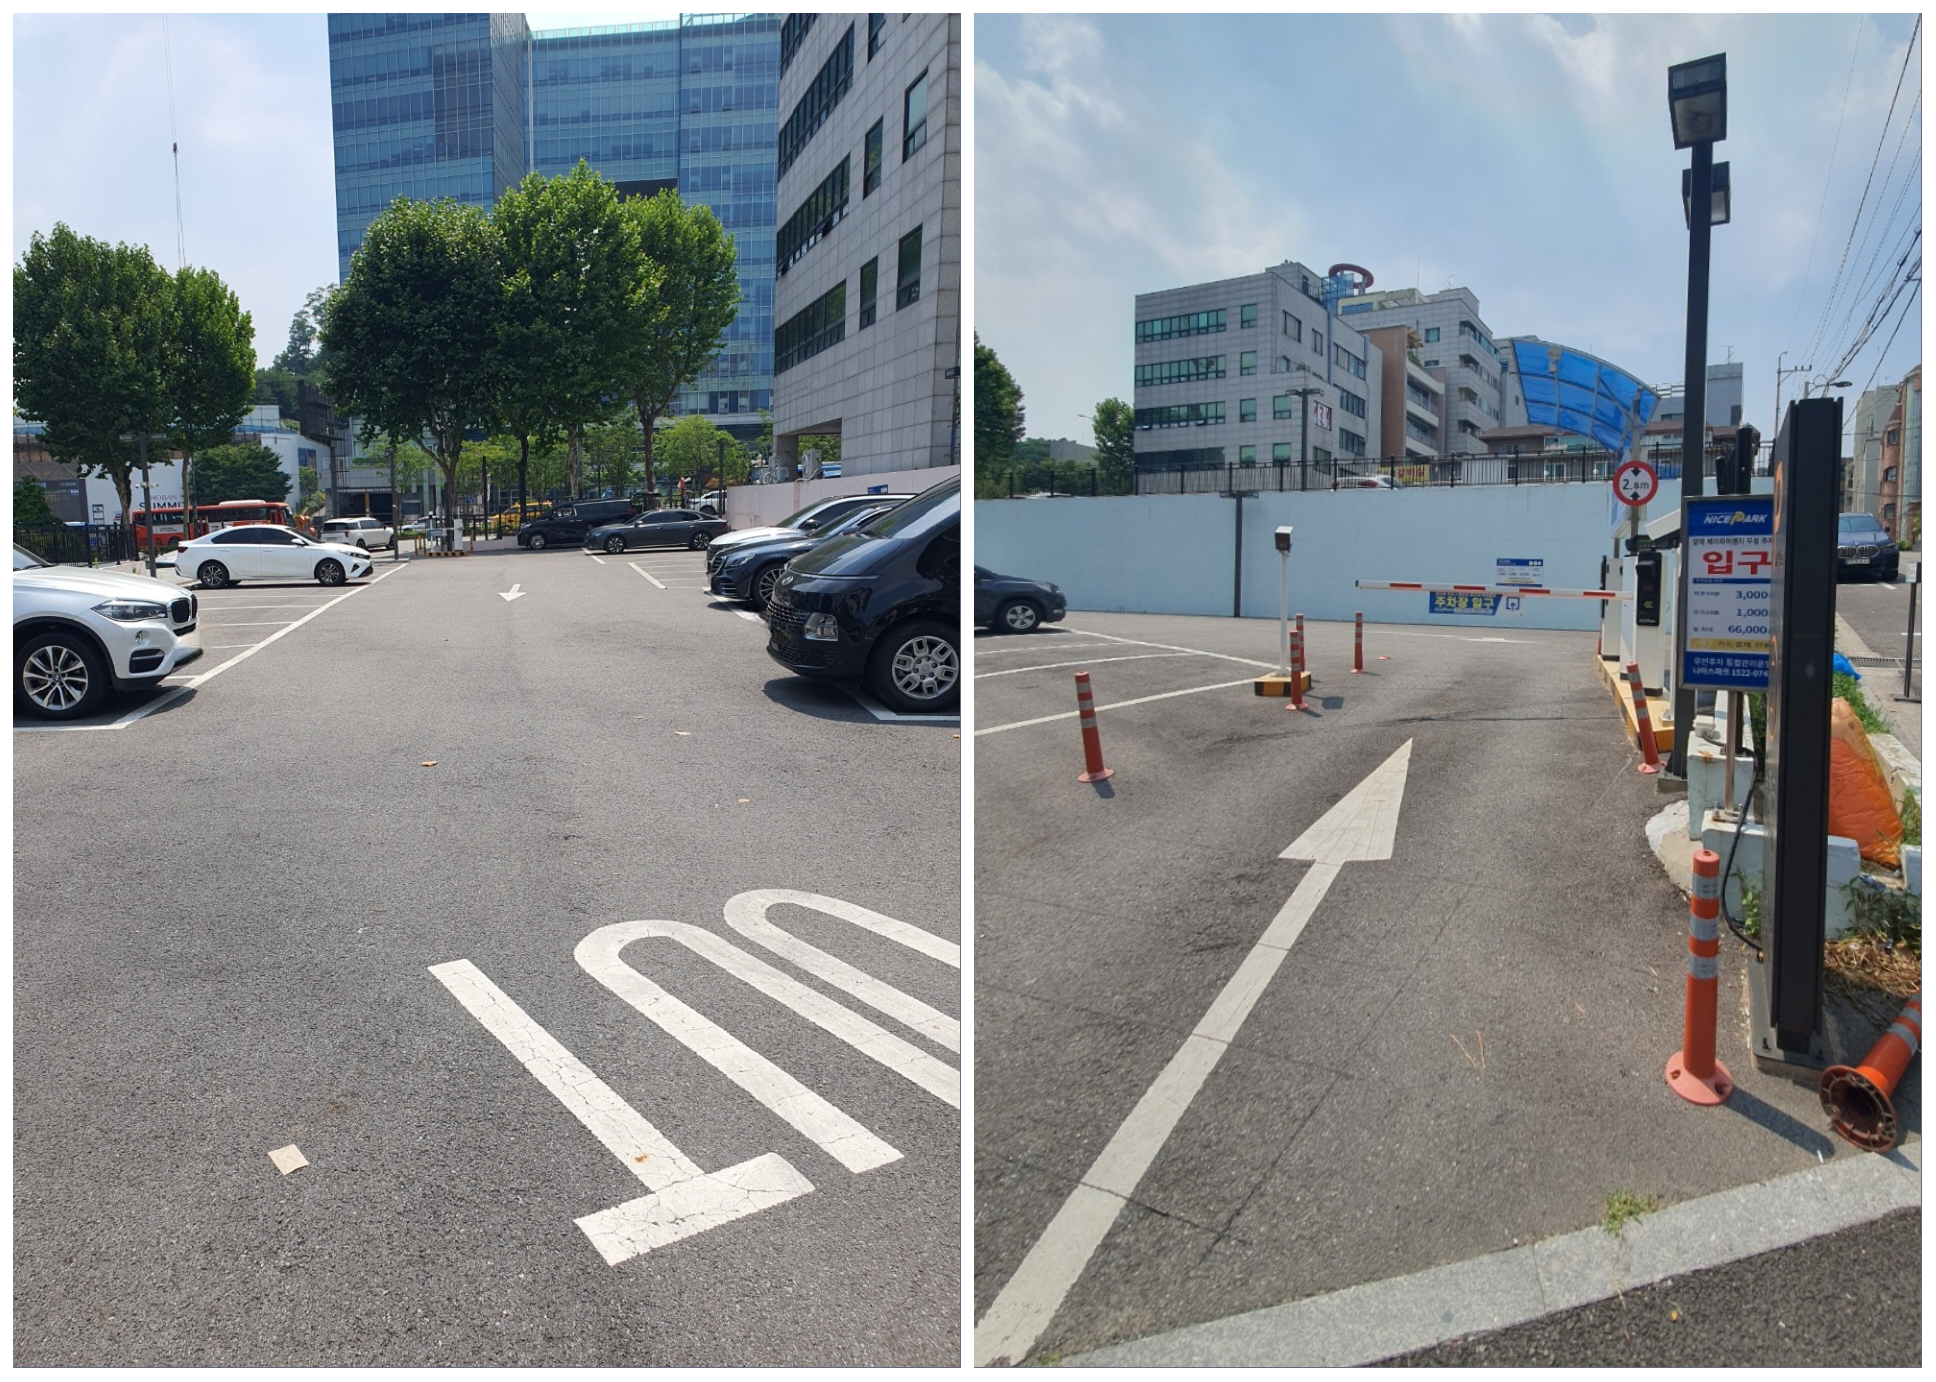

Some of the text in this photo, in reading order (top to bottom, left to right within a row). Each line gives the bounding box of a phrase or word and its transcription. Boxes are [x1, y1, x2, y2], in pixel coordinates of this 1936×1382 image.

[1622, 478, 1650, 490] 2.8m
[1703, 511, 1768, 525] NICEPARK
[1702, 550, 1772, 575] 입구
[1735, 590, 1768, 600] 3,000
[1434, 596, 1495, 609] 주차장 입구
[1736, 608, 1769, 618] 1,000
[1728, 625, 1768, 635] 66,000
